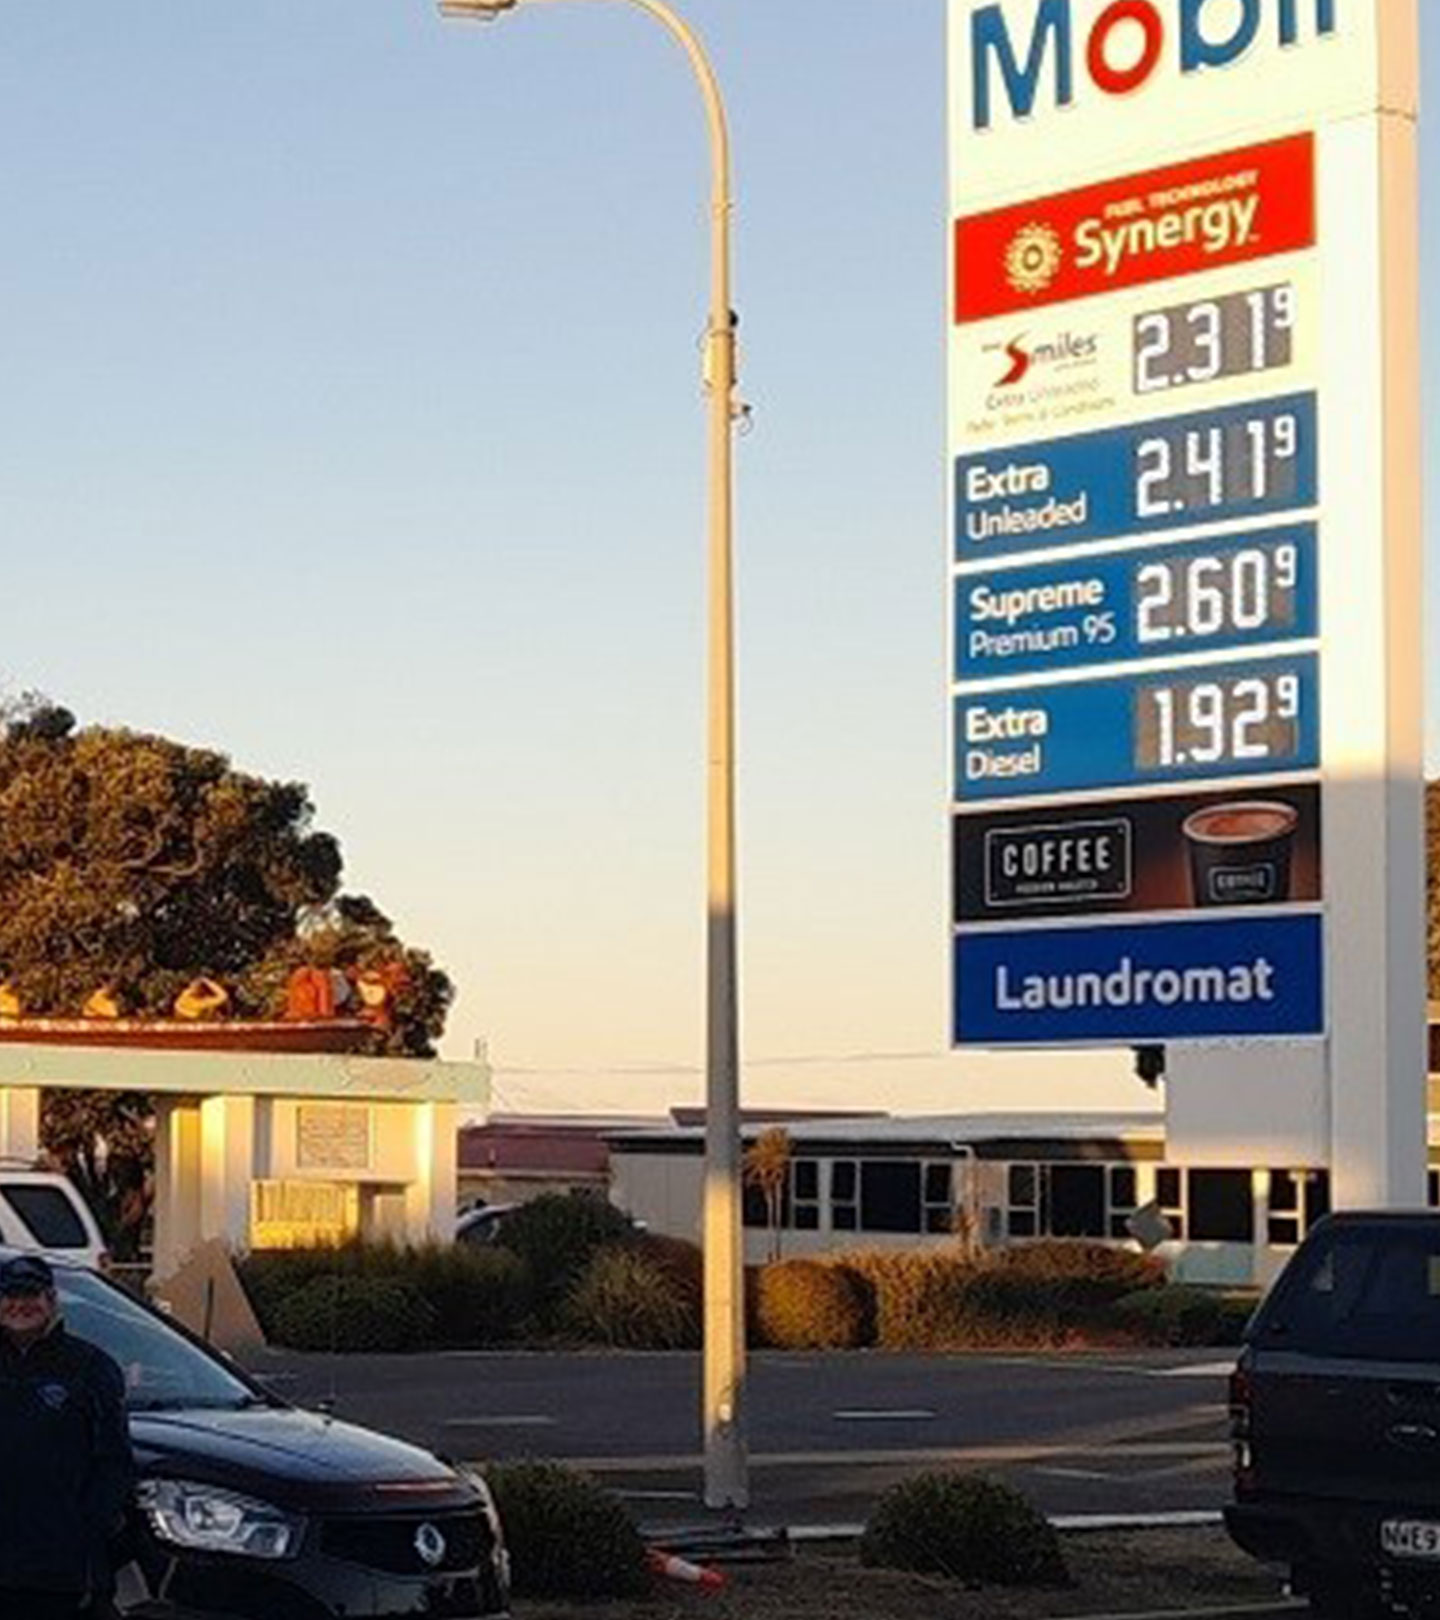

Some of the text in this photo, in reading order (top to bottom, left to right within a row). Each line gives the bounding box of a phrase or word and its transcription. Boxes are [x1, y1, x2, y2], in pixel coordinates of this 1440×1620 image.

[1074, 193, 1259, 276] Synergy
[966, 463, 1050, 501] Extra
[967, 491, 1087, 540] Unleaded
[970, 578, 1105, 624] Supreme
[970, 612, 1117, 659] Premium 95
[966, 706, 1048, 742] Extra
[966, 744, 1041, 780] Diesel
[1003, 836, 1110, 877] COFFEE
[996, 956, 1274, 1011] Laundromat
